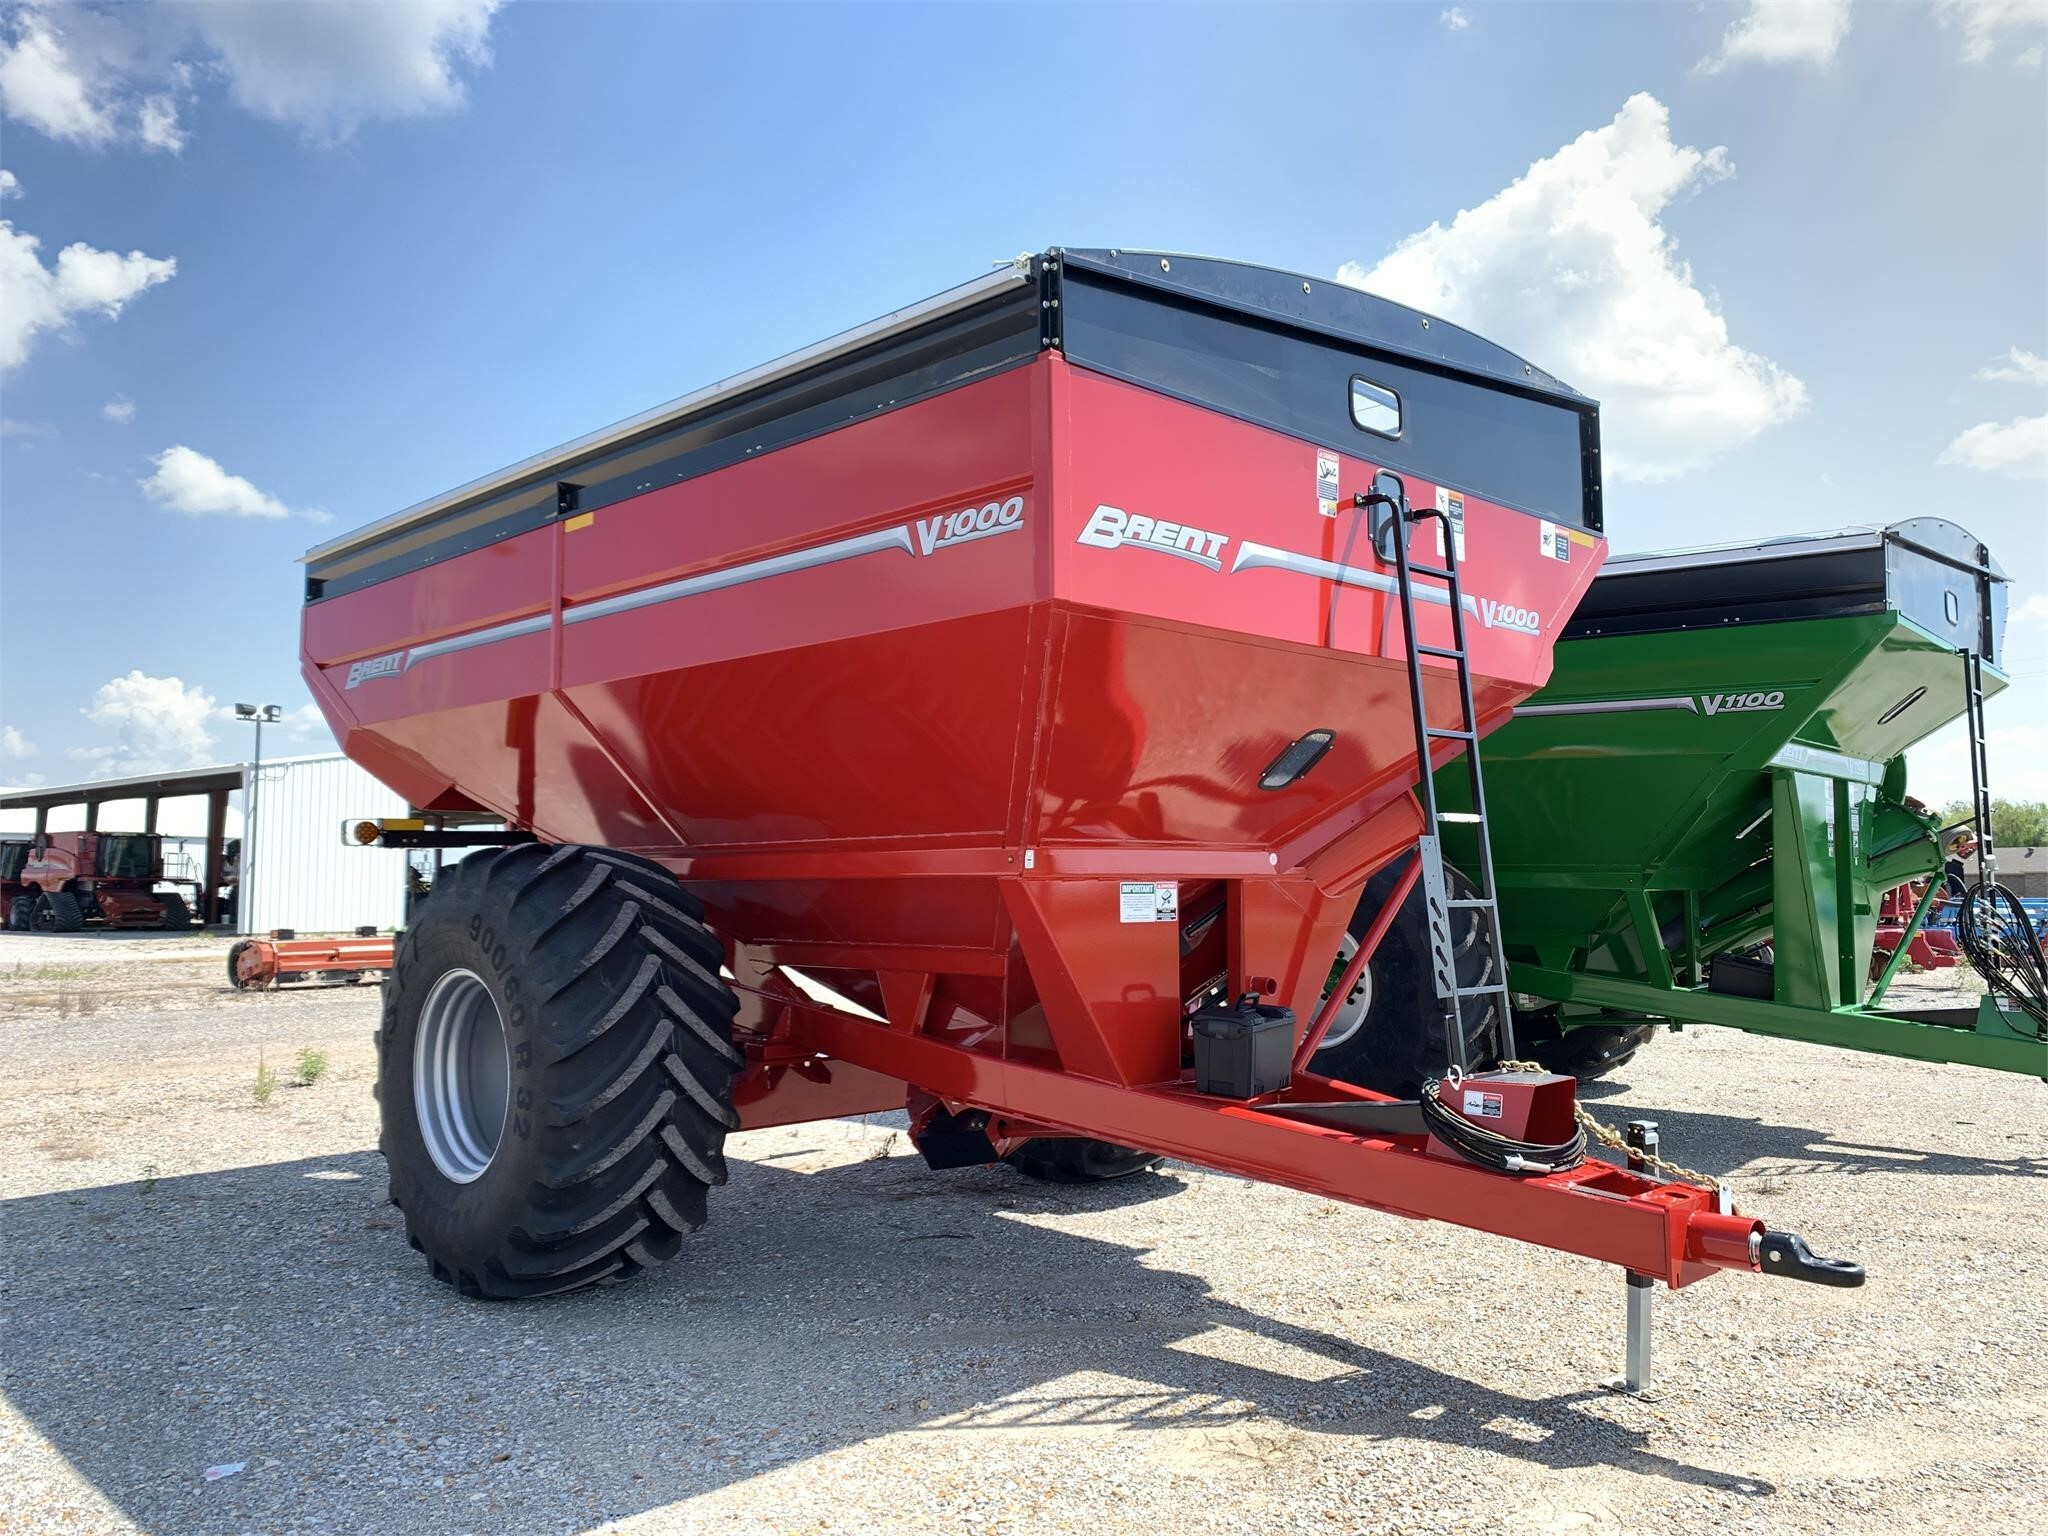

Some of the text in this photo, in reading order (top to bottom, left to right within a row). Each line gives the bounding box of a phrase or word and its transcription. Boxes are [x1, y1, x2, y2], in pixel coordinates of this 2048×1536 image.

[916, 496, 1024, 556] V1000
[1076, 503, 1230, 561] BRENT
[1480, 597, 1540, 632] V1000
[344, 651, 404, 690] BRENT
[1701, 691, 1785, 716] V1100
[1121, 884, 1154, 894] IMPORTANT
